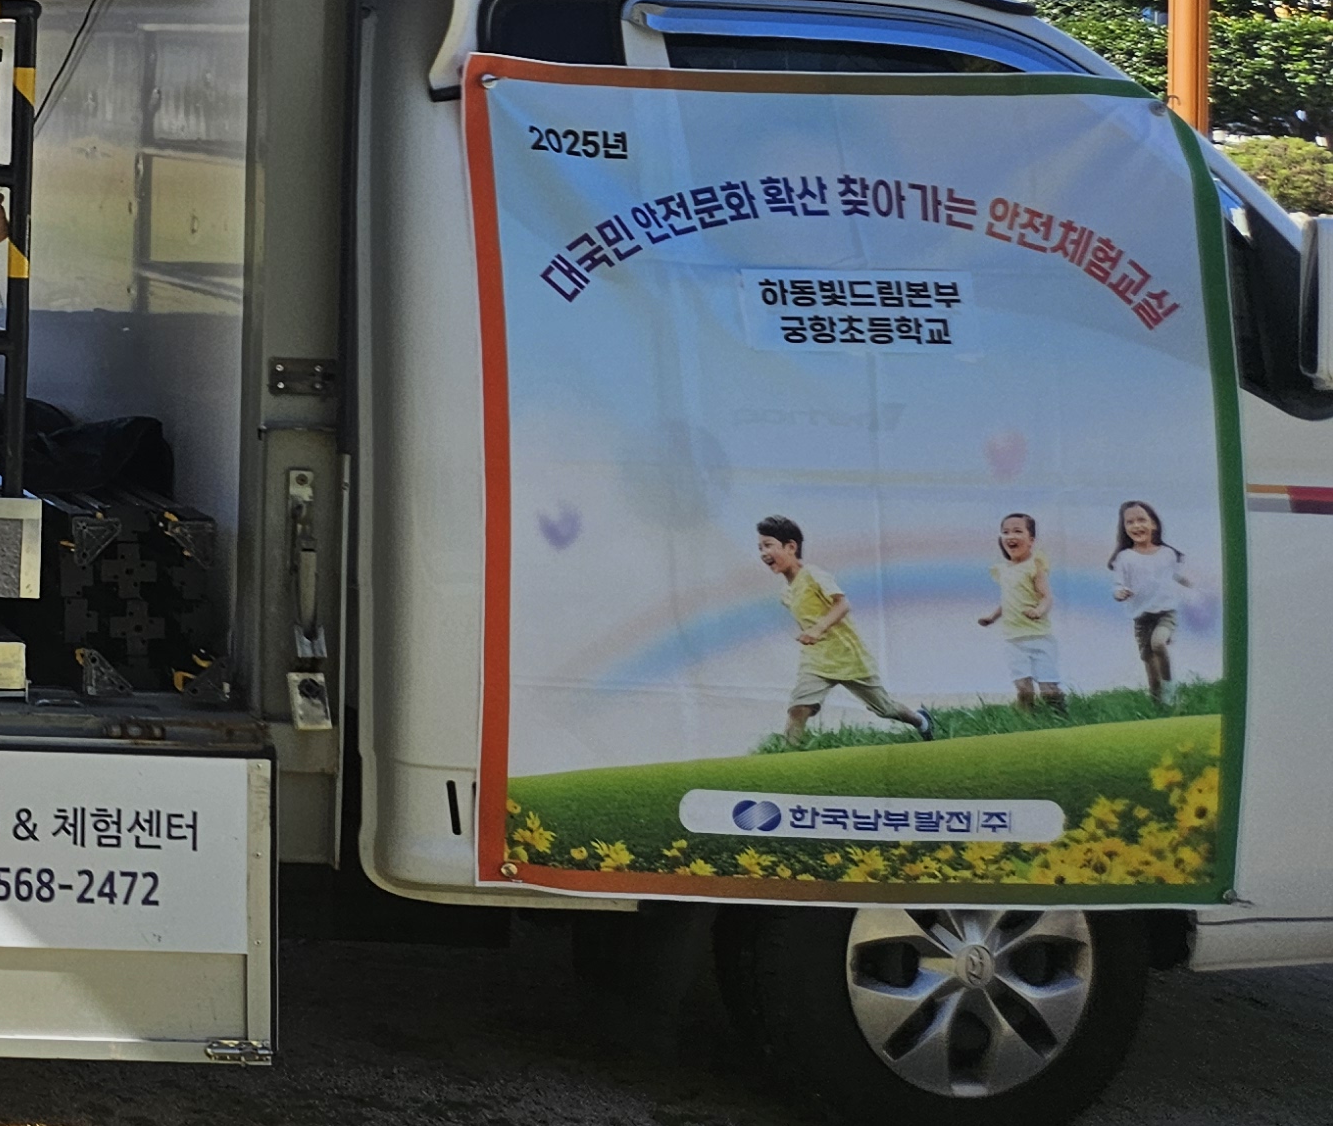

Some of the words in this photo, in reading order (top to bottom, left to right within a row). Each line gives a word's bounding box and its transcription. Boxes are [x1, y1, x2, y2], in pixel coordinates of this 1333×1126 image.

[528, 125, 628, 160] 2025년
[540, 215, 643, 303] 대국민
[632, 180, 760, 245] 안전문화
[760, 176, 830, 218] 확산
[837, 175, 977, 231] 찾아가는
[985, 197, 1181, 331] 안전체험교실
[759, 278, 962, 308] 하동빛드림본부
[780, 315, 952, 345] 궁항초등학교
[12, 807, 40, 842] &
[51, 806, 199, 851] 체험센터
